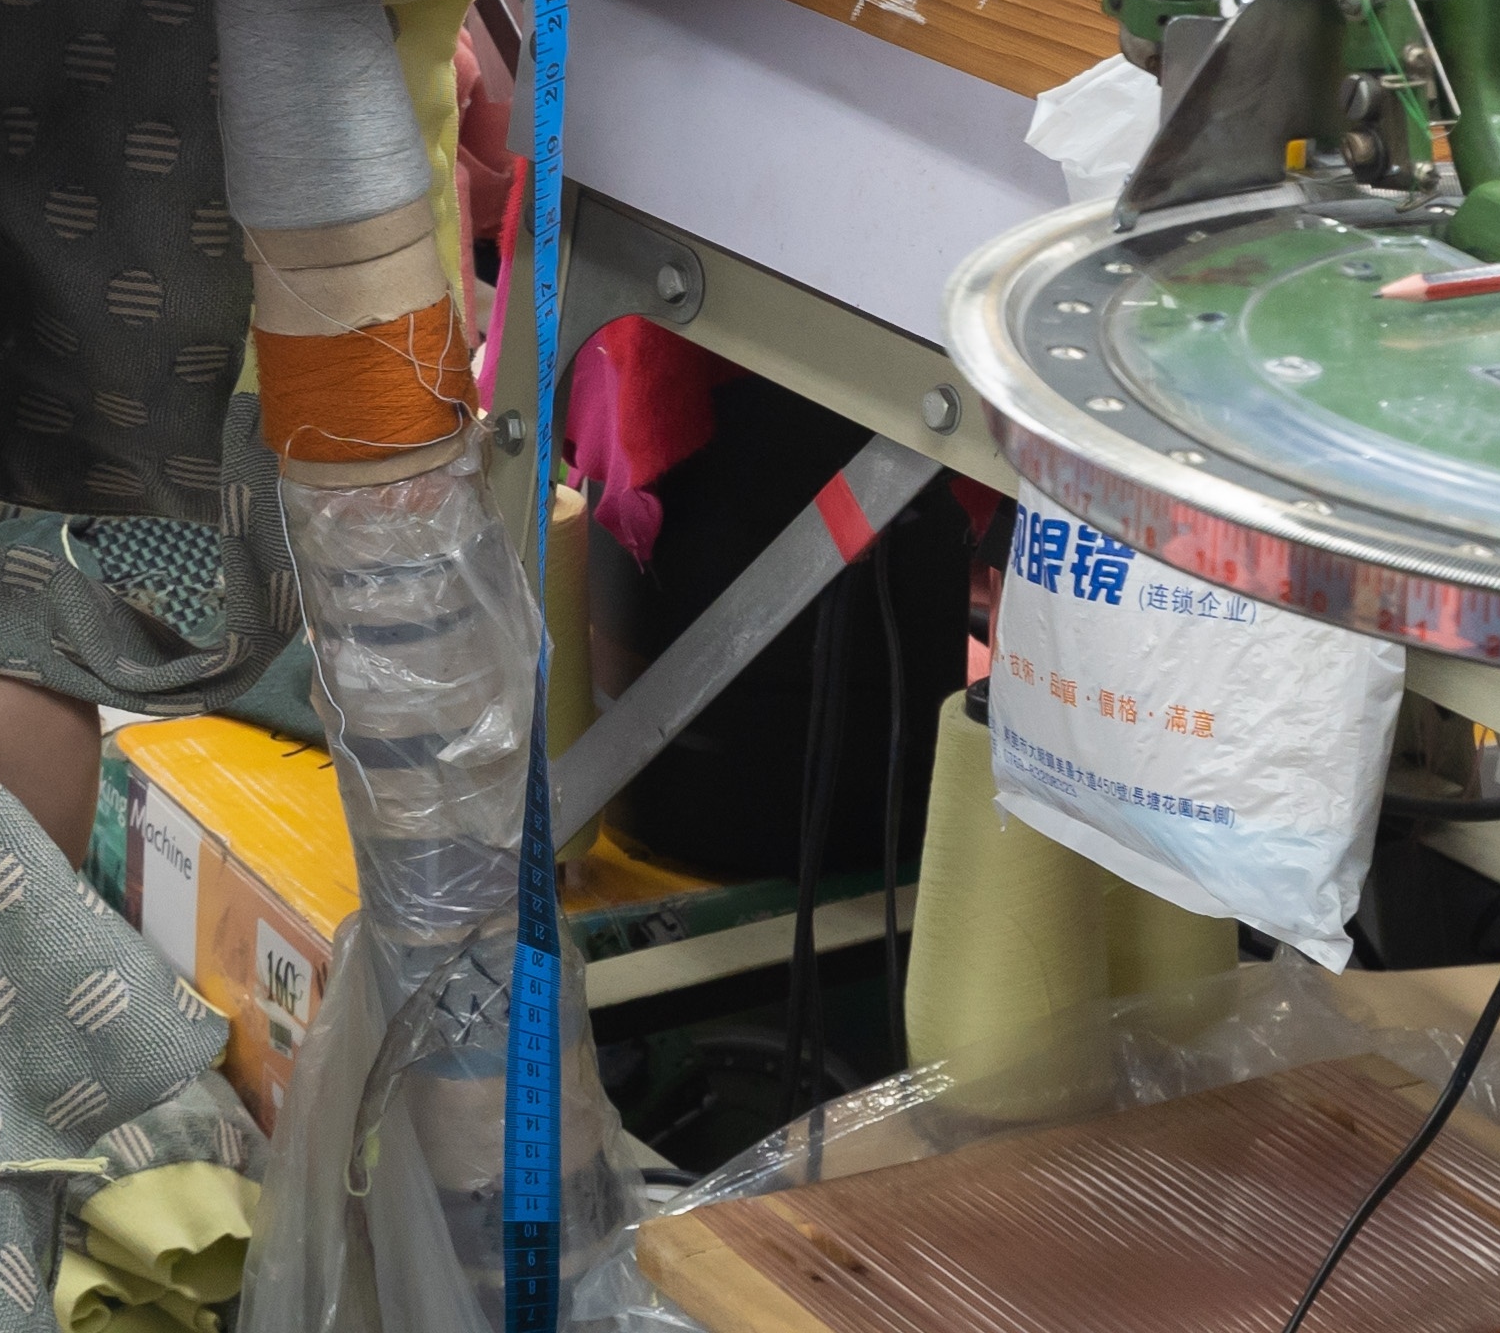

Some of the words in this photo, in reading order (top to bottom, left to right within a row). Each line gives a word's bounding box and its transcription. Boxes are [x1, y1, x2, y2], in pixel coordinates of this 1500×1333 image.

[545, 61, 559, 105] 20
[130, 799, 192, 880] Machine
[532, 952, 544, 967] 20
[530, 979, 542, 995] 19
[529, 1007, 540, 1023] 18
[527, 1036, 540, 1051] 17
[527, 1063, 540, 1077] 16
[527, 1090, 540, 1104] 15
[526, 1117, 540, 1132] 14
[526, 1144, 539, 1159] 13
[524, 1171, 538, 1185] 12
[526, 1198, 538, 1211] 11
[524, 1223, 537, 1238] 10
[528, 1253, 535, 1267] 9
[528, 1280, 536, 1295] 8
[528, 1308, 535, 1322] 7
